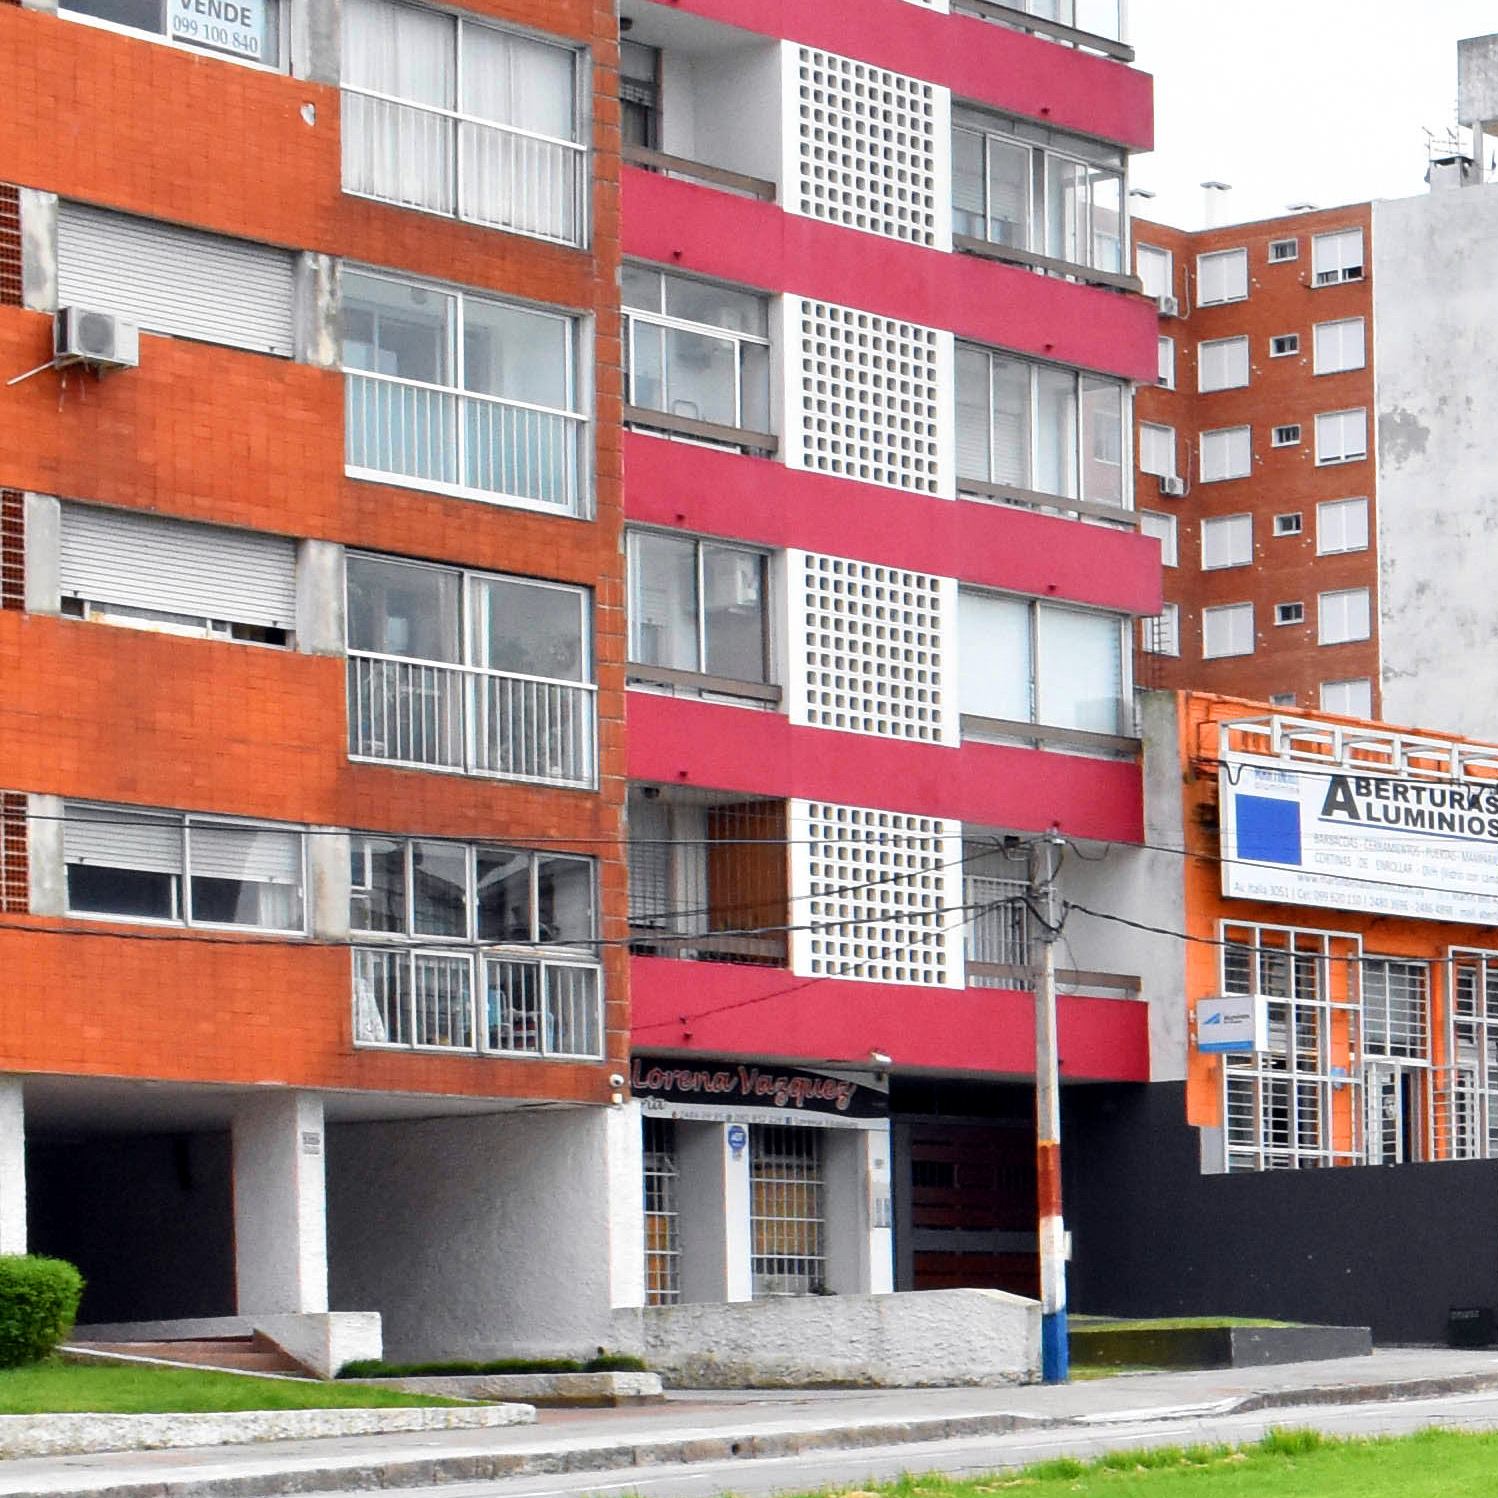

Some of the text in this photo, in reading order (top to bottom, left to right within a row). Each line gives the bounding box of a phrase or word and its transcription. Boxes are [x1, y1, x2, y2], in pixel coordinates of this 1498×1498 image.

[173, 14, 258, 53] 099 100 840
[631, 1058, 857, 1110] Lorena Vazquez
